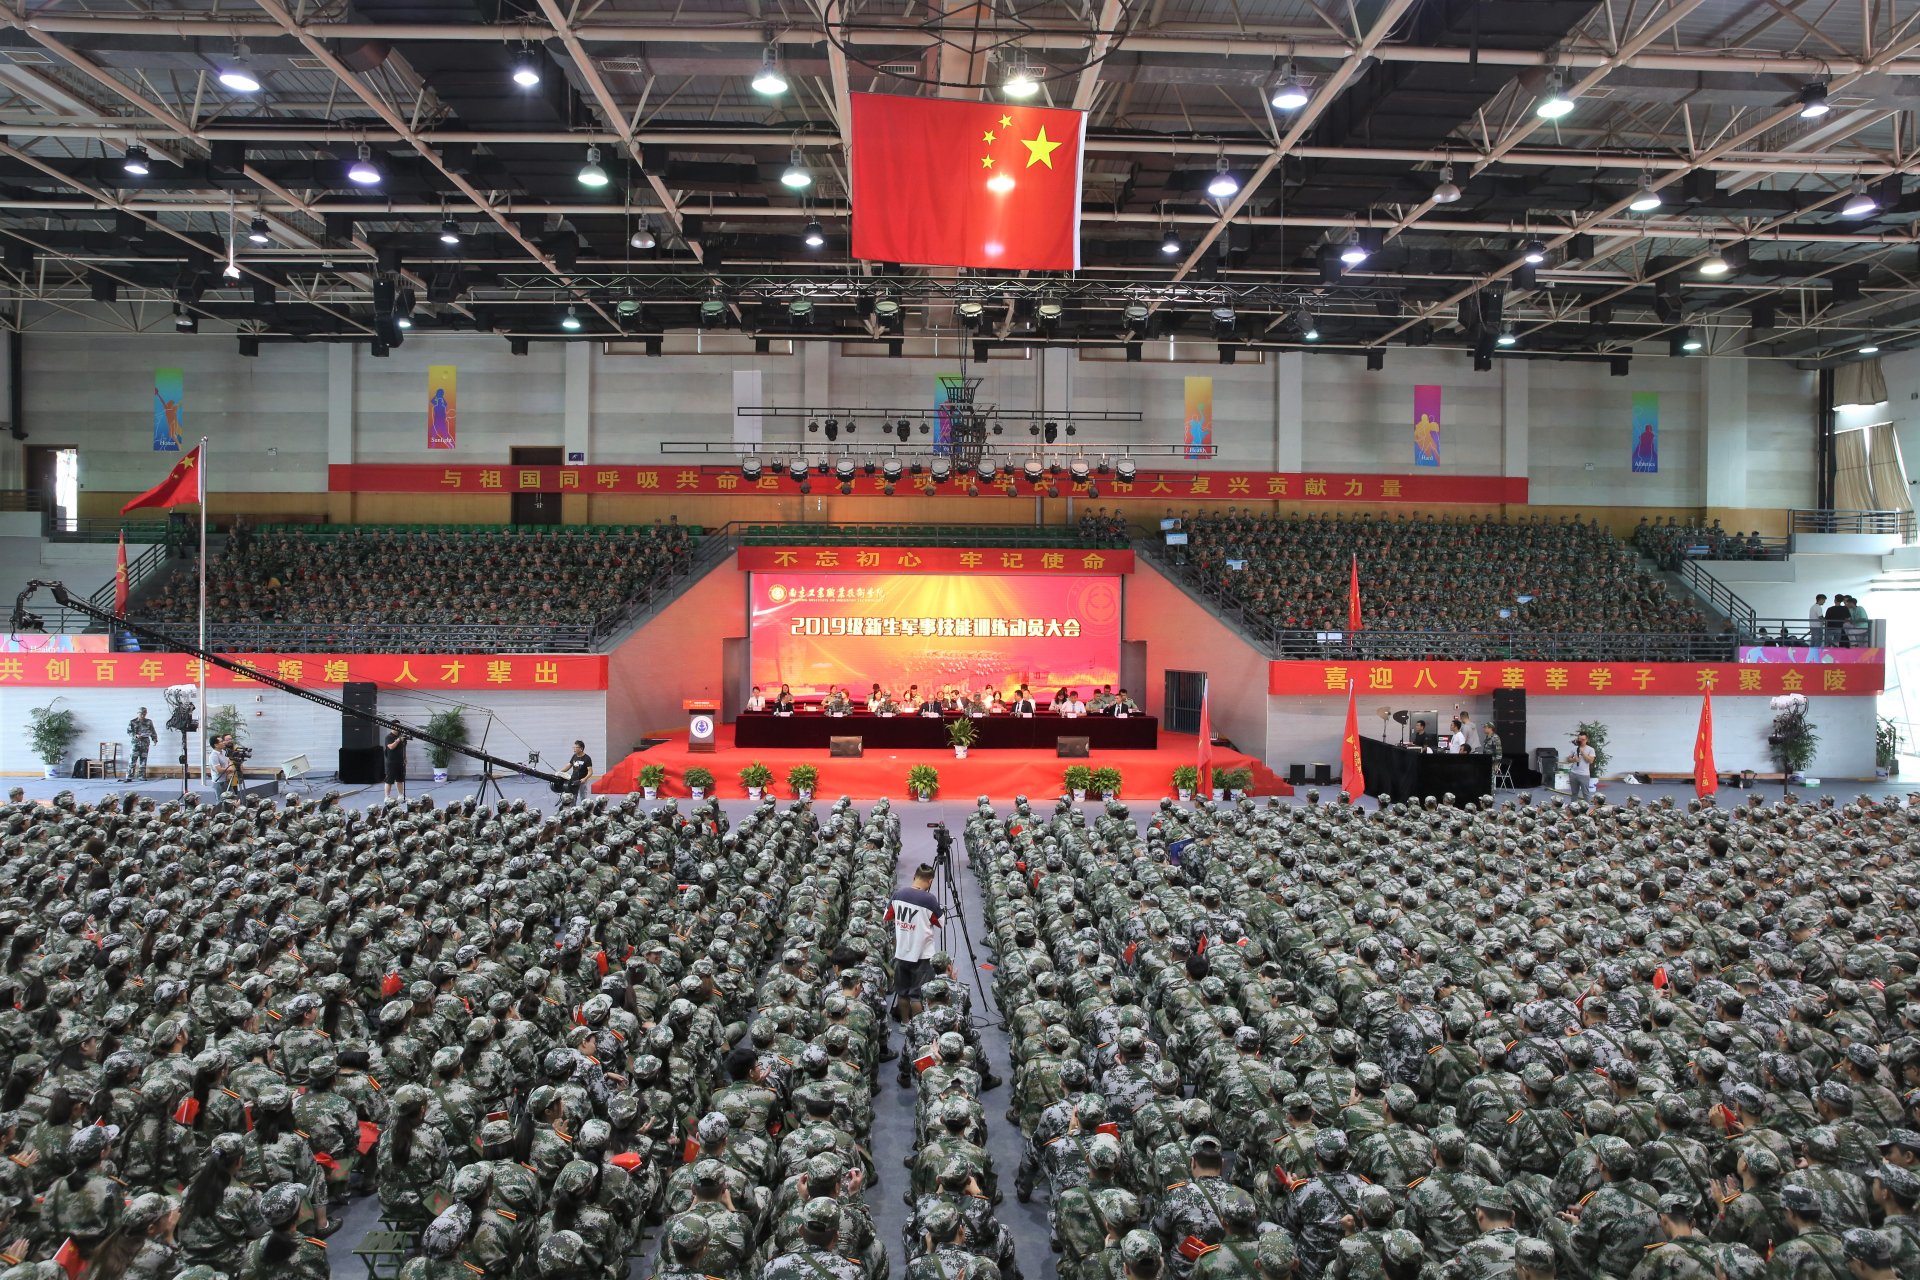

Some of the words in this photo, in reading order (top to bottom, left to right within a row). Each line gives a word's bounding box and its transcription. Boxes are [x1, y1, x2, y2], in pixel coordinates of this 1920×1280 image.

[774, 550, 923, 569] 不忘初心
[959, 551, 1107, 570] 牢记使命
[791, 616, 1081, 638] 2019级新生军事技能训练动员大会
[399, 659, 560, 684] 人才辈出
[1324, 666, 1656, 691] 喜迎八方莘莘学子
[1696, 667, 1848, 692] 齐聚金陵
[896, 905, 919, 923] NY
